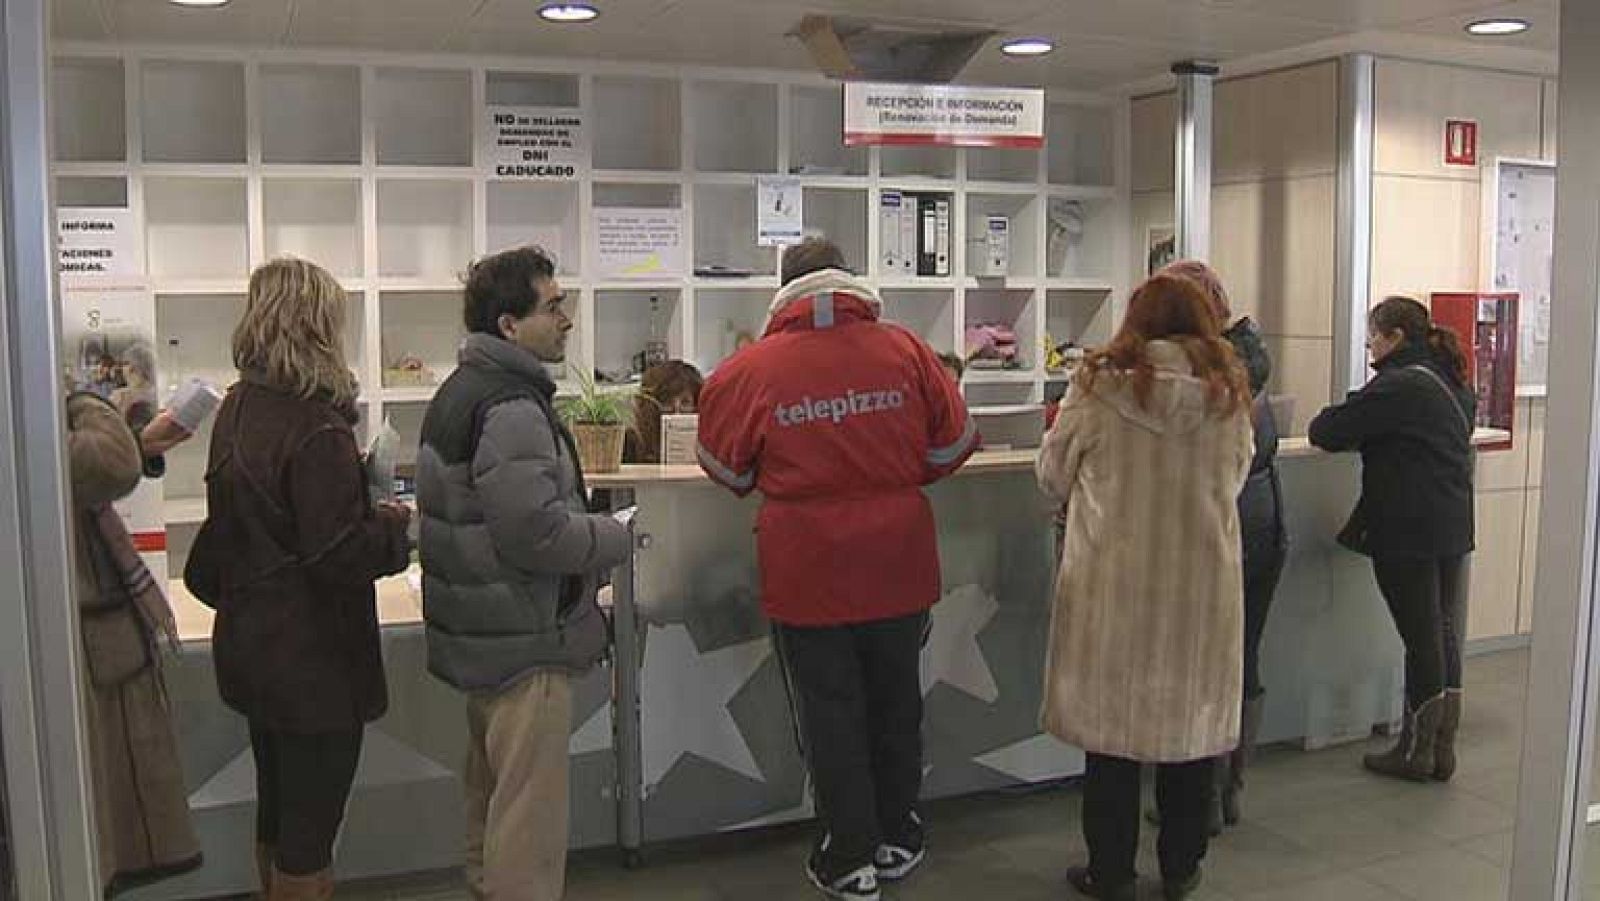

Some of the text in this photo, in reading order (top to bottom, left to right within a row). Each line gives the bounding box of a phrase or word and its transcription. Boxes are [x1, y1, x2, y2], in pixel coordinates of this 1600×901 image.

[494, 113, 515, 125] NO
[523, 150, 548, 161] DNI
[496, 166, 575, 176] CADUCADO
[62, 221, 115, 230] INFORMA
